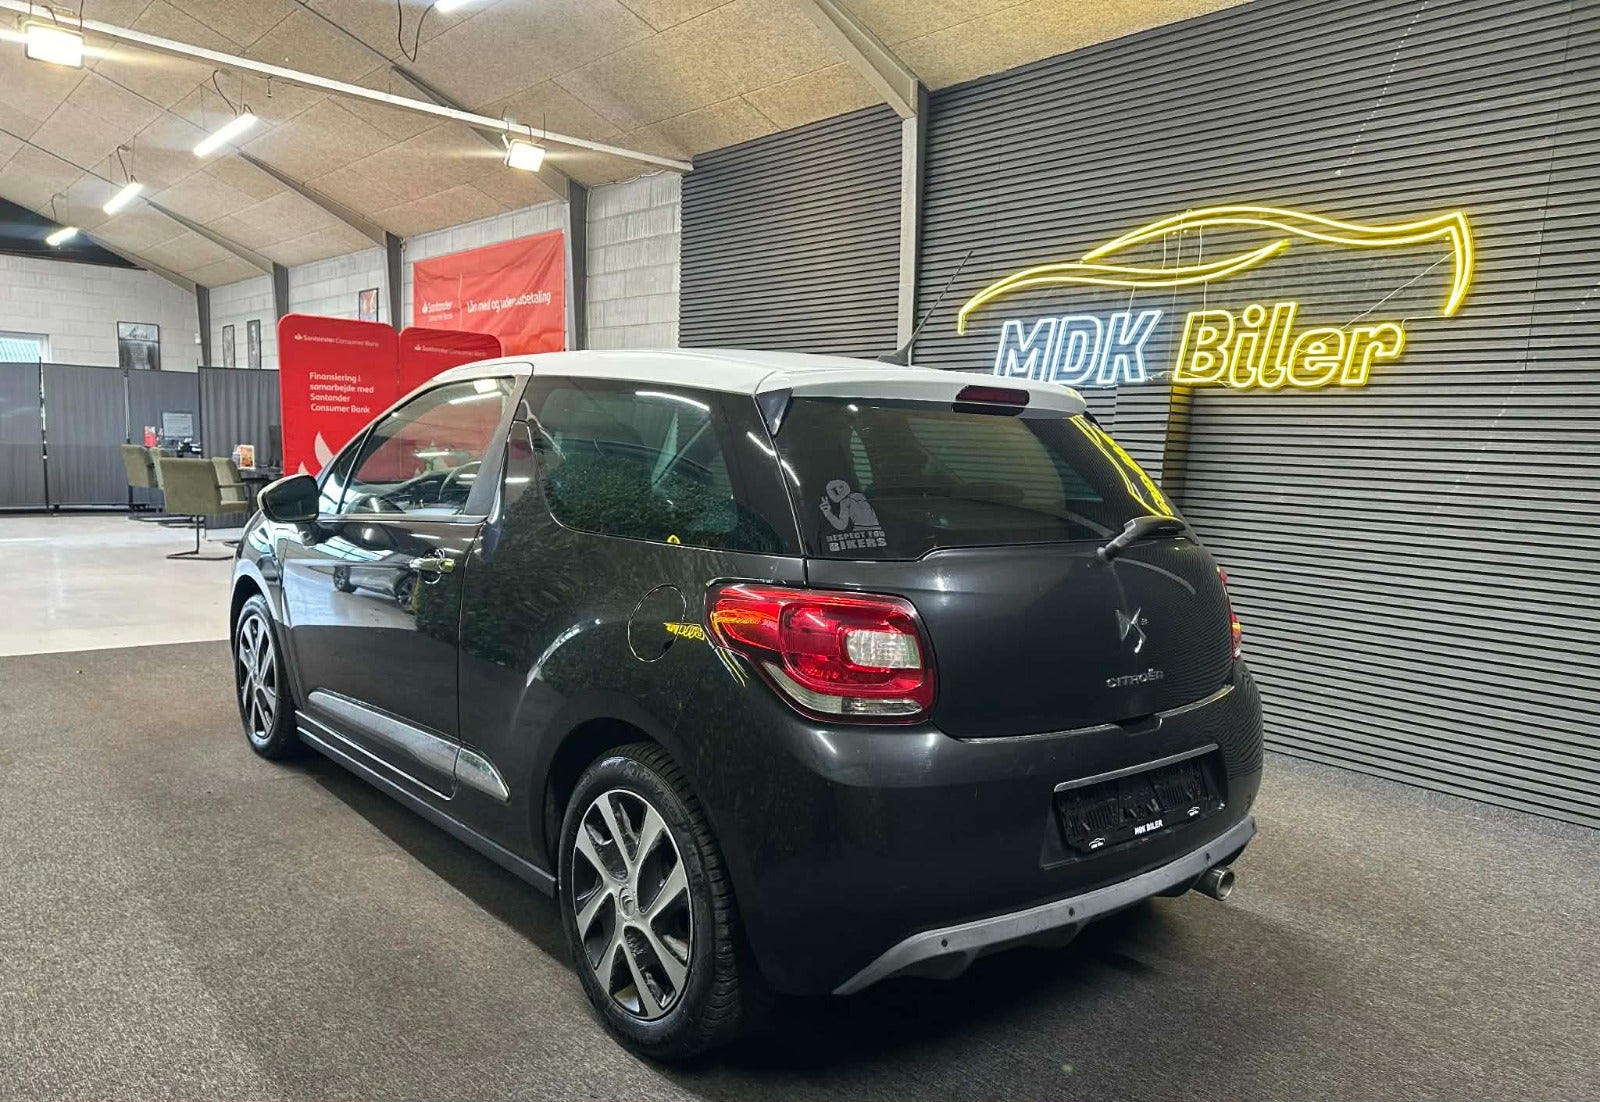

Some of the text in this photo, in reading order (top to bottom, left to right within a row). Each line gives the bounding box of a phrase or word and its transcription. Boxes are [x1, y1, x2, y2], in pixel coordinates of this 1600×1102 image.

[491, 300, 500, 312] og
[303, 334, 335, 344] Santander
[335, 337, 364, 347] Consumer
[993, 301, 1406, 389] MDK Biler
[309, 371, 357, 384] Finansiering
[309, 384, 374, 394] samarbejde med
[310, 393, 350, 402] Santander
[310, 403, 370, 414] Consumer Bank
[826, 531, 866, 542] RESPECT
[829, 537, 888, 551] BIKERS
